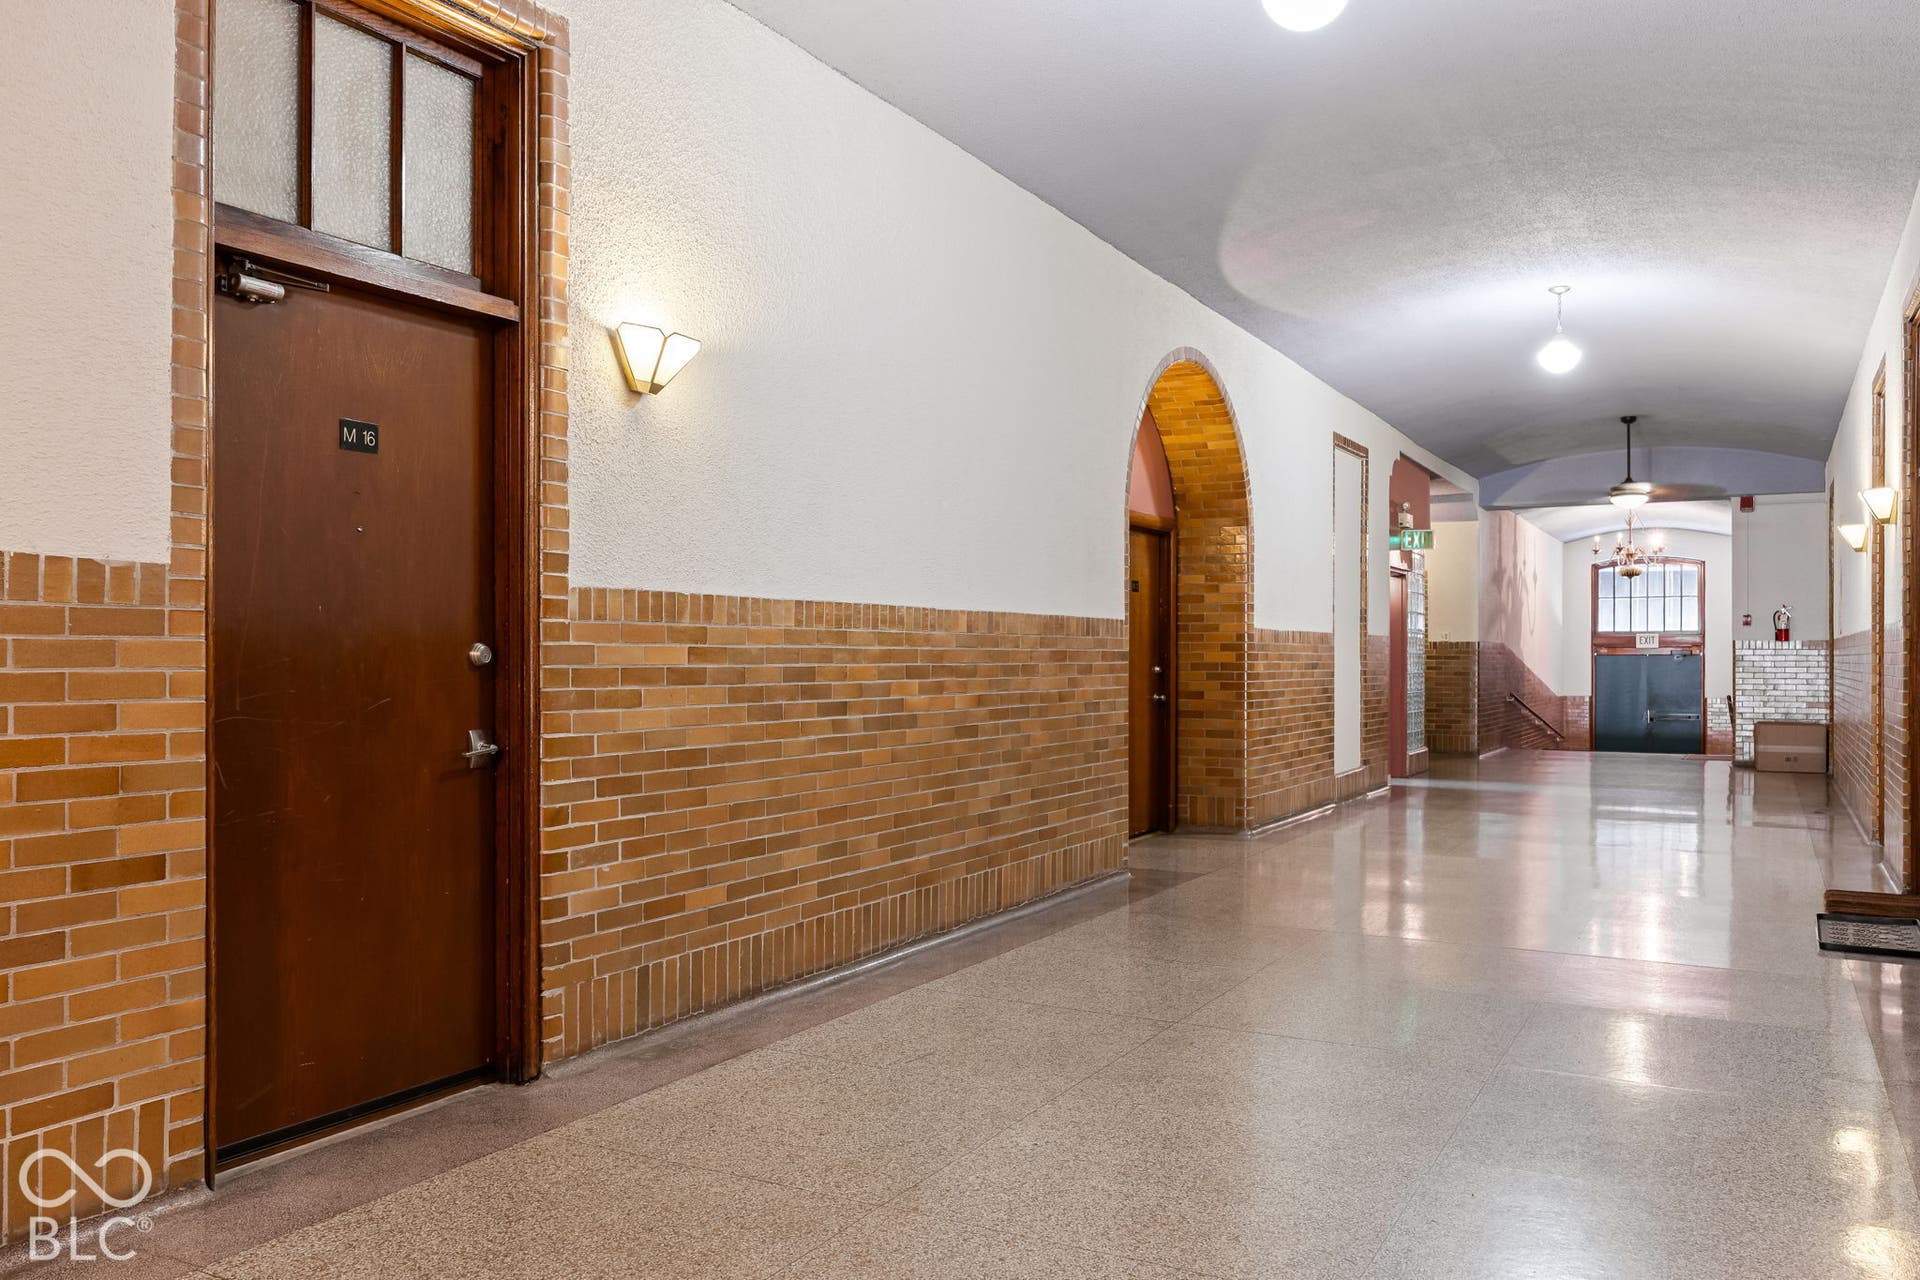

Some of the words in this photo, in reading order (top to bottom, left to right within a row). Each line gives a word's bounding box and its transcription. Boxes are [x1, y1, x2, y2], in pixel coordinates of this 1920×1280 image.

[343, 426, 356, 443] M
[362, 430, 376, 447] 16
[1405, 531, 1432, 549] EXIT
[1639, 635, 1655, 645] EXIT
